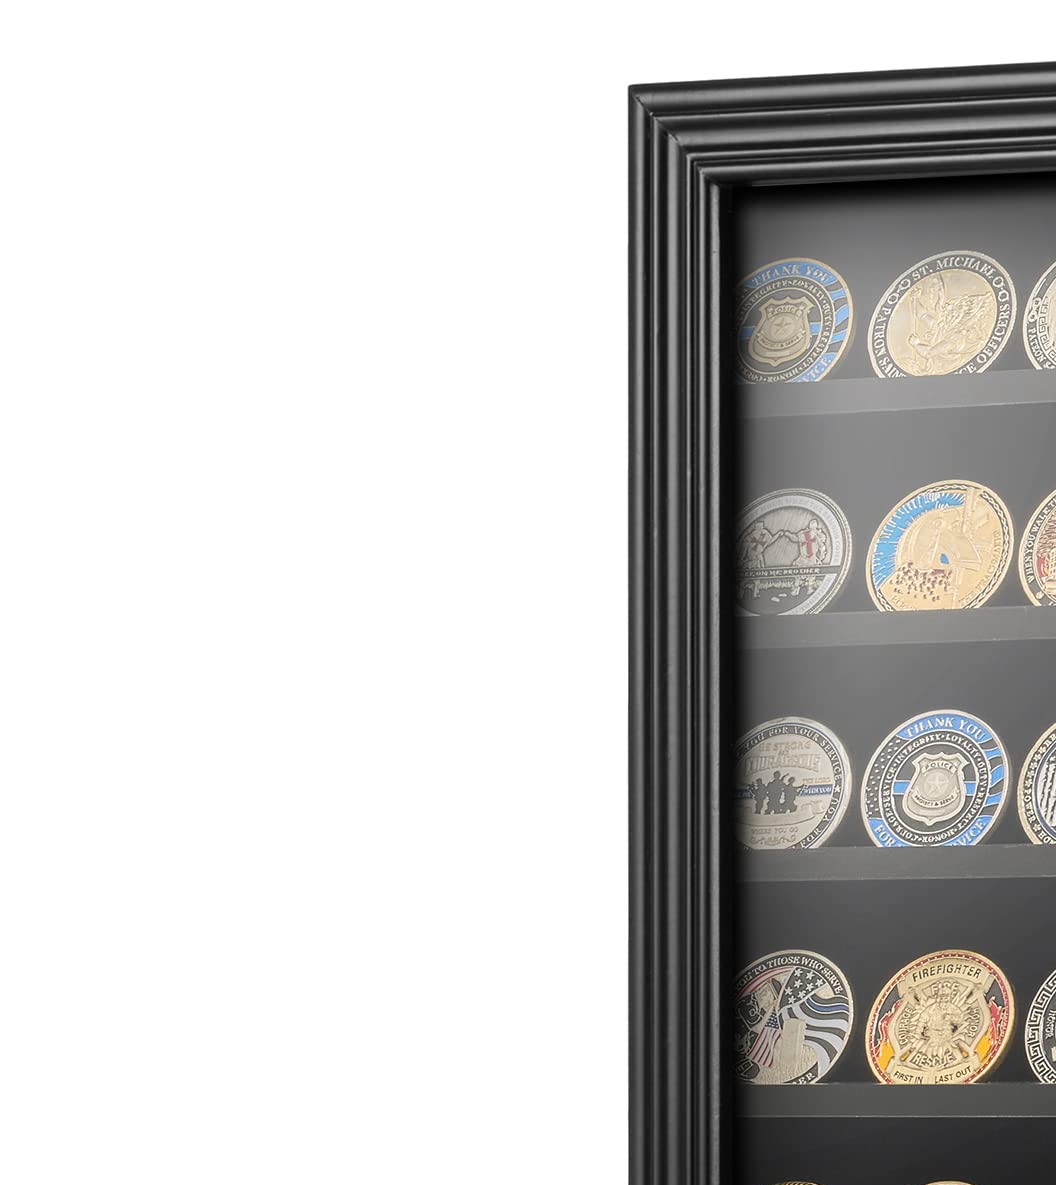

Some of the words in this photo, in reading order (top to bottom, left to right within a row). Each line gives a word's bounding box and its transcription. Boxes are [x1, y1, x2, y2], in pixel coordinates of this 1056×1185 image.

[912, 265, 935, 283] ST.
[936, 259, 1002, 283] MICHAEL
[873, 309, 893, 347] PATRON
[905, 719, 953, 738] THANK
[957, 719, 987, 741] YOU
[924, 761, 953, 770] POLICE
[766, 956, 800, 971] THOSE
[801, 957, 823, 970] WHO
[821, 965, 843, 994] SERVE
[912, 963, 982, 982] FIREFIGHTER
[912, 1052, 955, 1067] RESCUE
[893, 1069, 914, 1082] FIRST
[914, 1074, 924, 1083] IN
[934, 1071, 952, 1084] LAST
[953, 1066, 972, 1079] OUT
